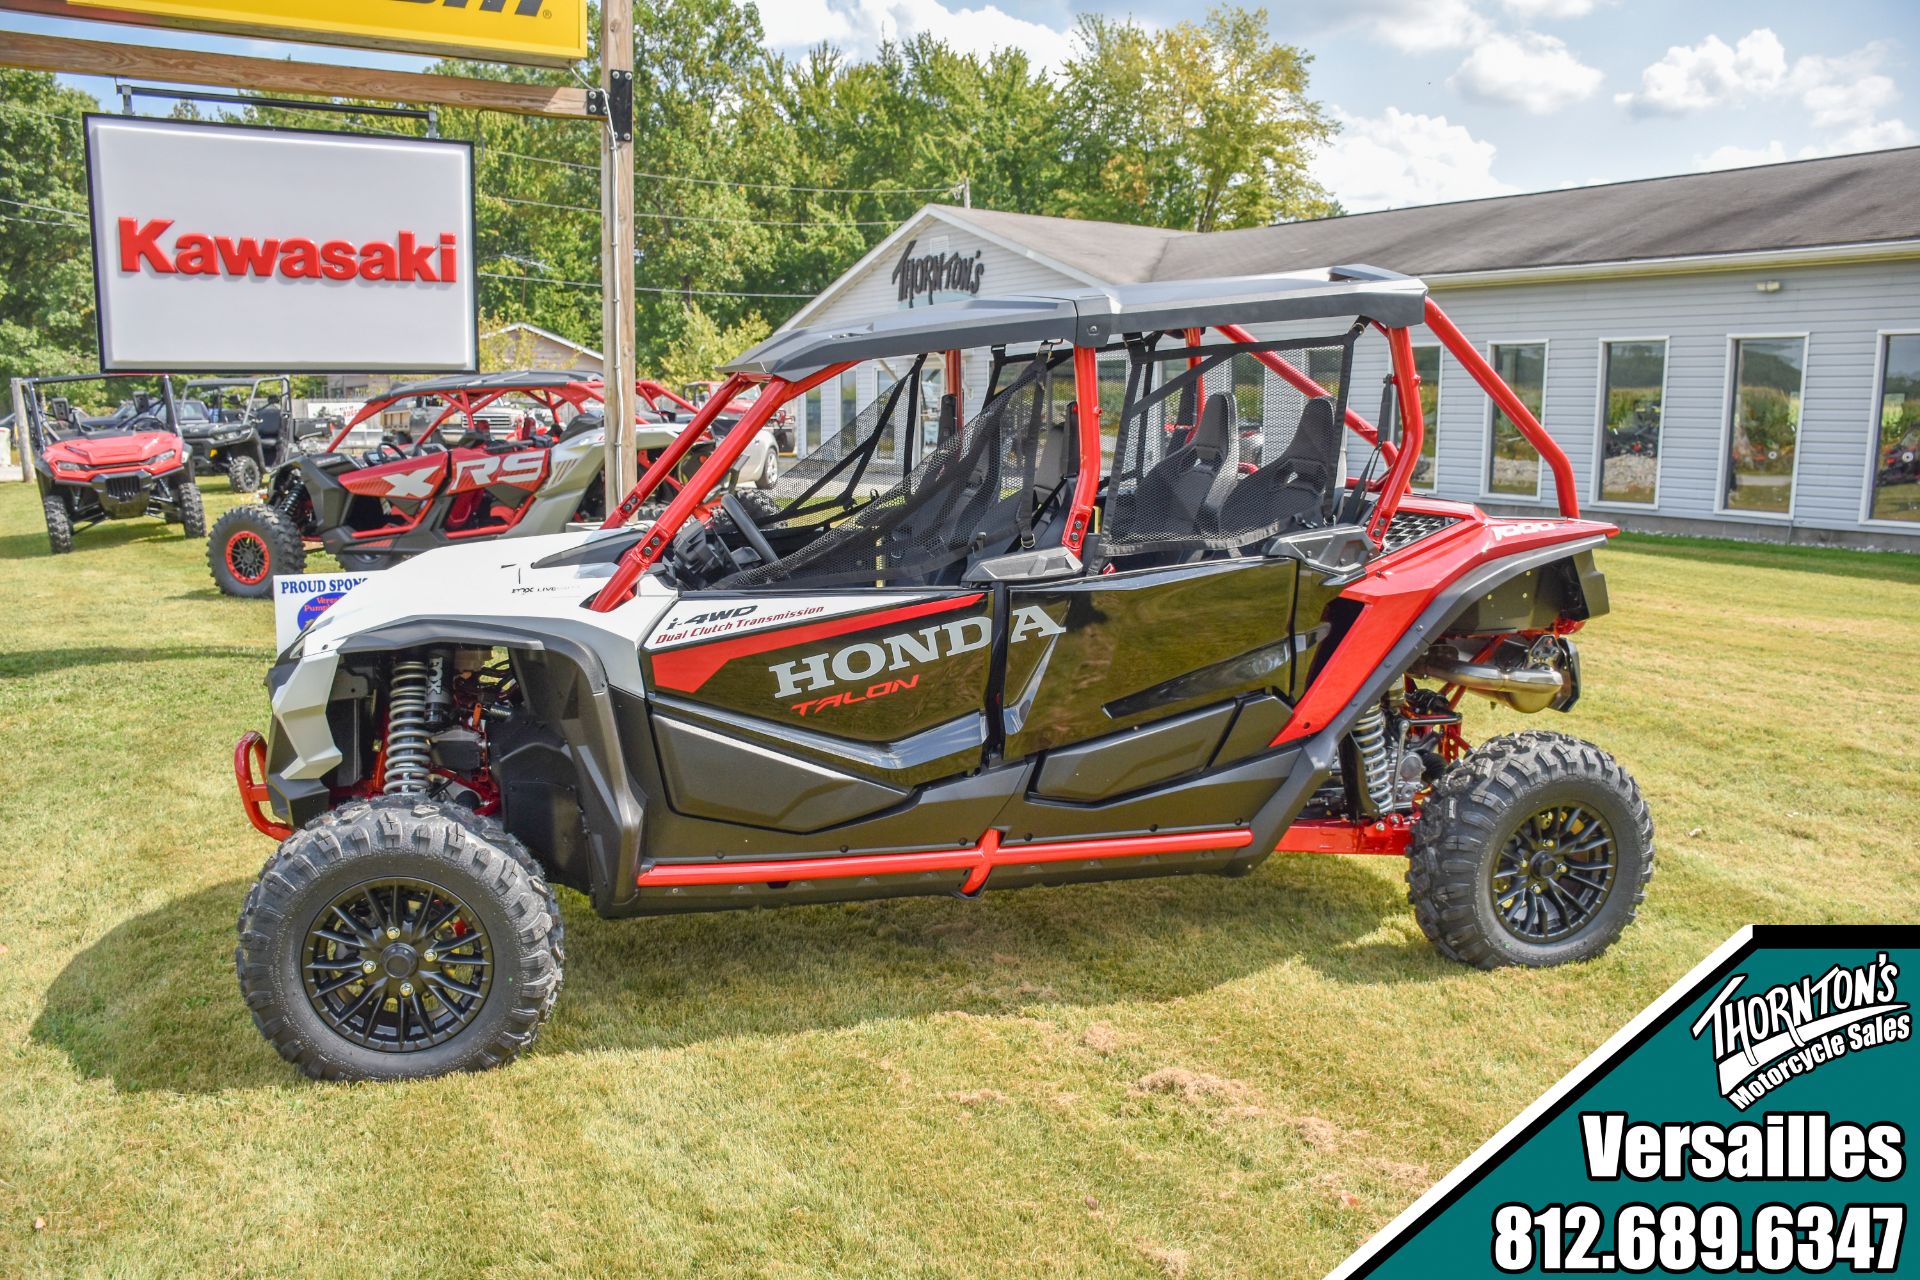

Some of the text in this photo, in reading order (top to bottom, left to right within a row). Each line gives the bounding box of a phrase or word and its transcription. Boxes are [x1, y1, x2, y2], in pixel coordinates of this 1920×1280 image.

[117, 215, 457, 284] Kawasaki
[281, 579, 326, 594] PROUD
[655, 606, 825, 644] Dual Clutch Transmission
[666, 605, 758, 631] i-4WD
[768, 605, 1067, 699] HONDA
[428, 656, 443, 695] FOX
[791, 674, 920, 717] TALON
